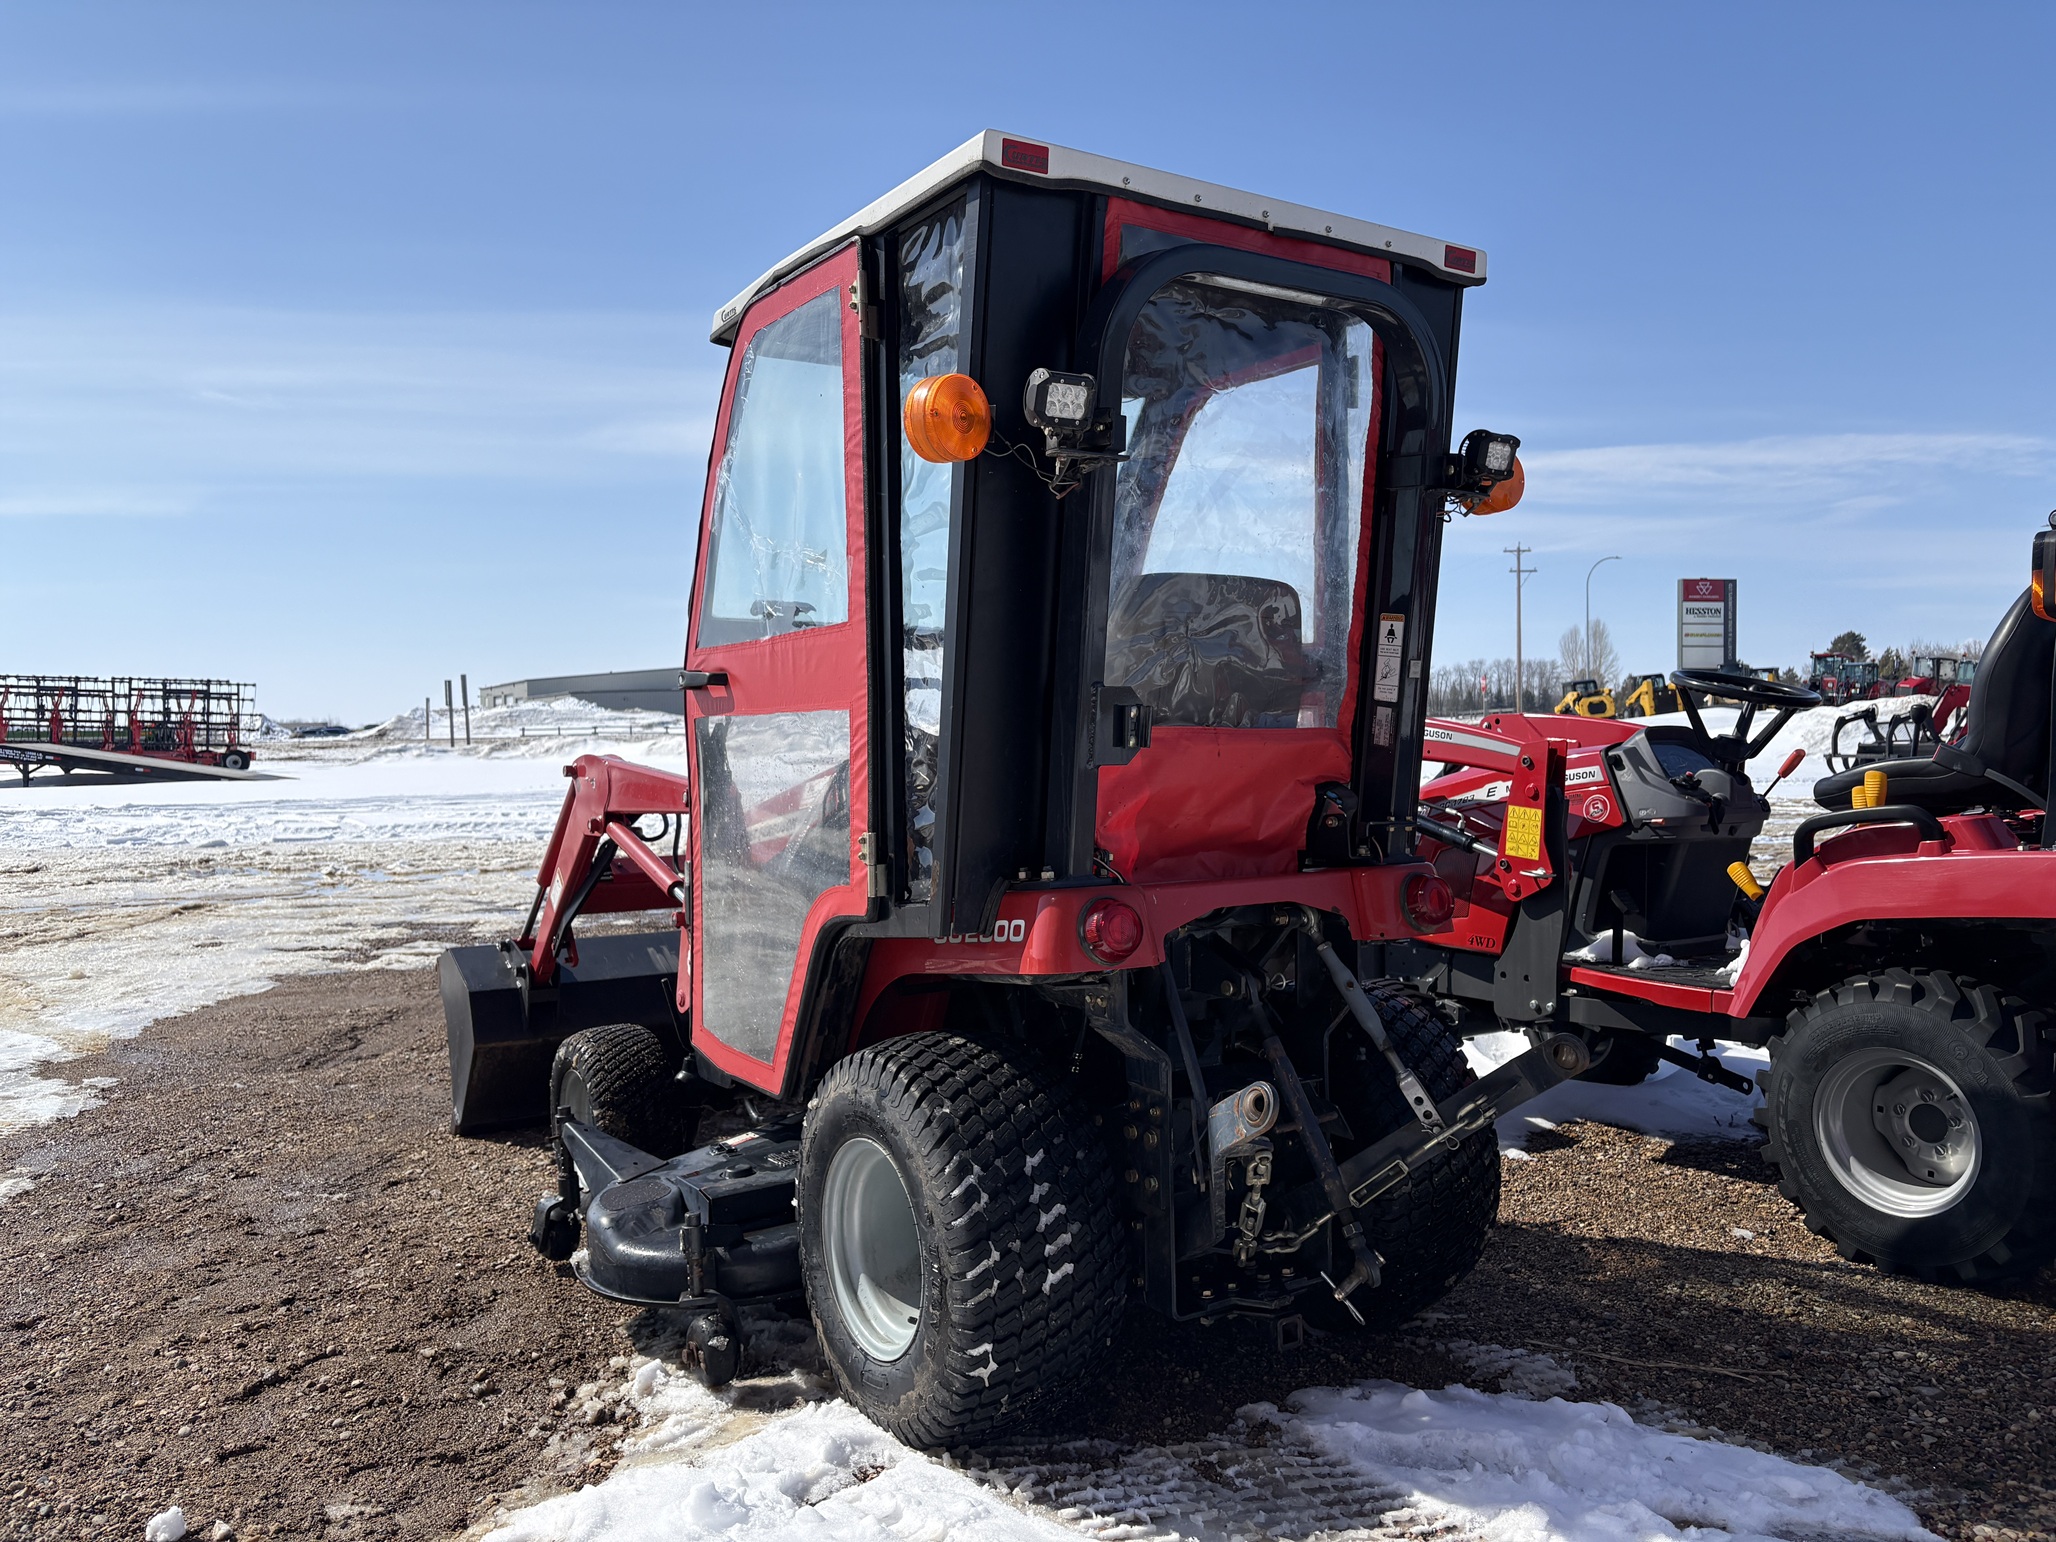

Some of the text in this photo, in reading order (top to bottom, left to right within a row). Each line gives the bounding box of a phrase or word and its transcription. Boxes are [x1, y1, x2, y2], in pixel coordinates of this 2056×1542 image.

[1685, 607, 1721, 615] HESSTON
[1486, 786, 1498, 798] E
[1592, 801, 1601, 811] 5
[1467, 934, 1496, 949] 4WD
